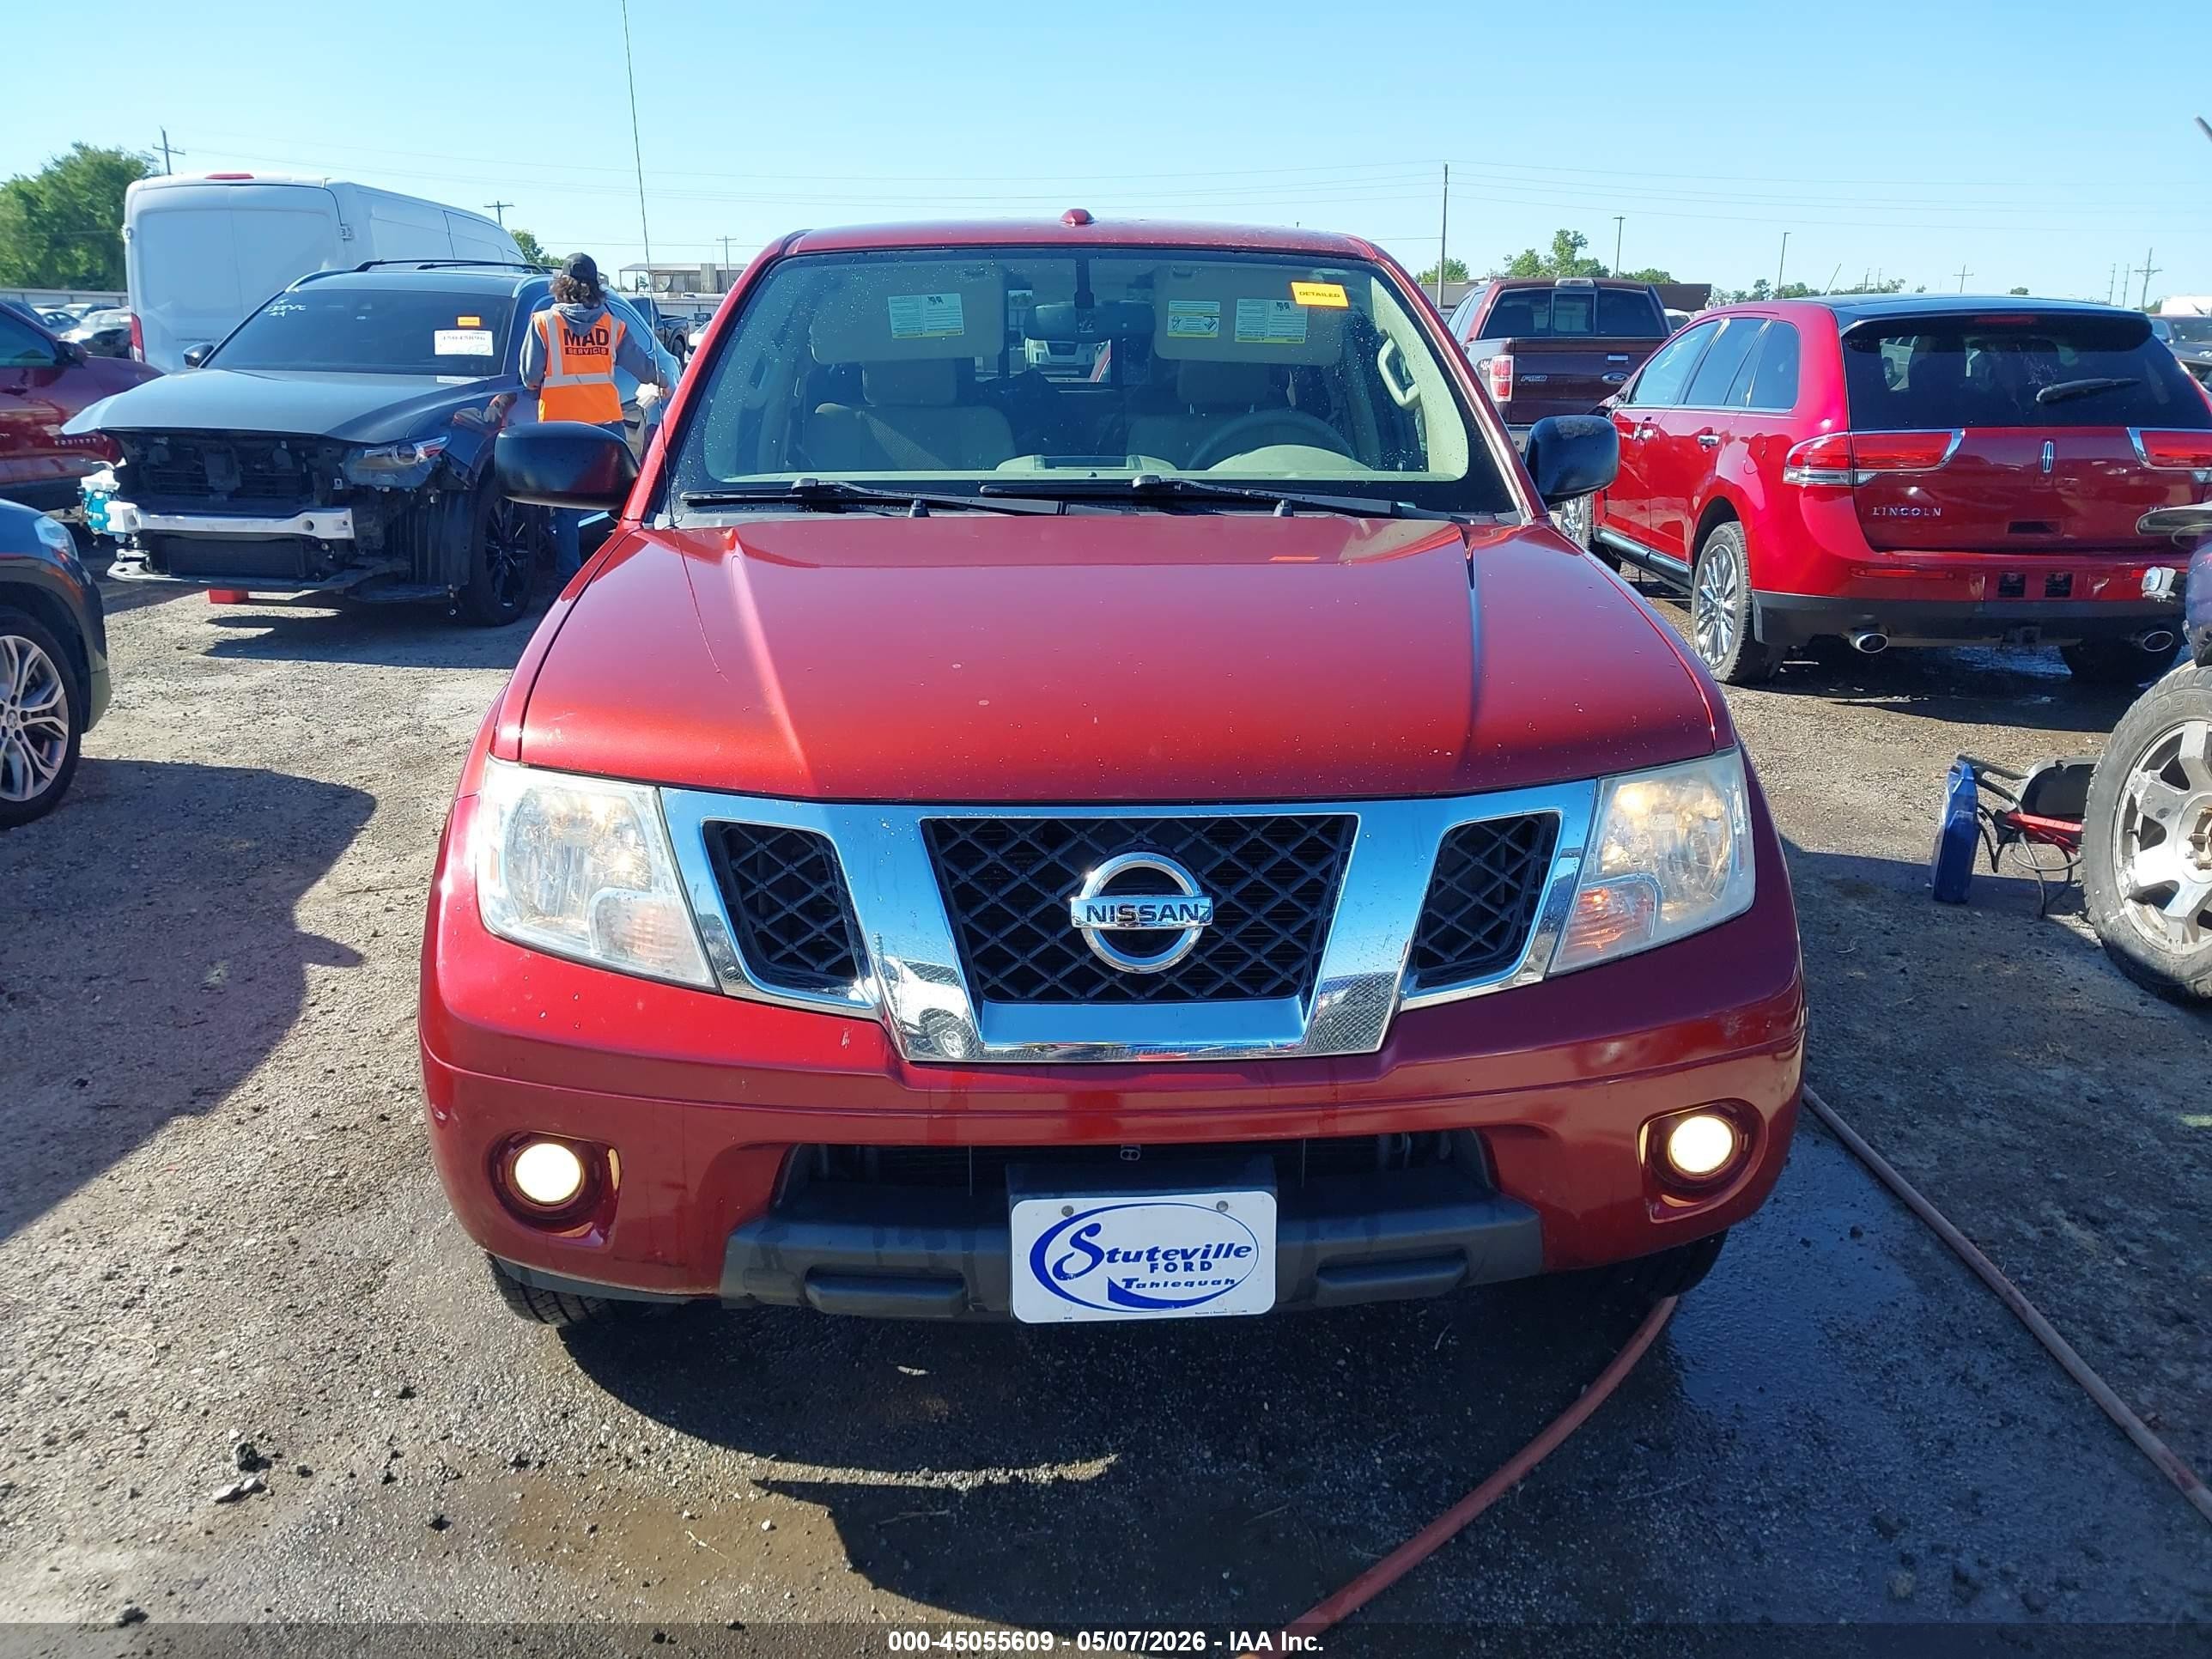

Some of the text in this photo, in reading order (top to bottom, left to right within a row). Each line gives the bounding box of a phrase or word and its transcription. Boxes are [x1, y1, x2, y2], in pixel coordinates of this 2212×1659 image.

[563, 327, 610, 347] MAD
[1872, 507, 1942, 516] LINCOLN
[1086, 903, 1199, 923] NISSAN
[1052, 1223, 1252, 1280] Stuteville
[1150, 1261, 1213, 1273] FORD
[1121, 1277, 1237, 1289] Tahlequah
